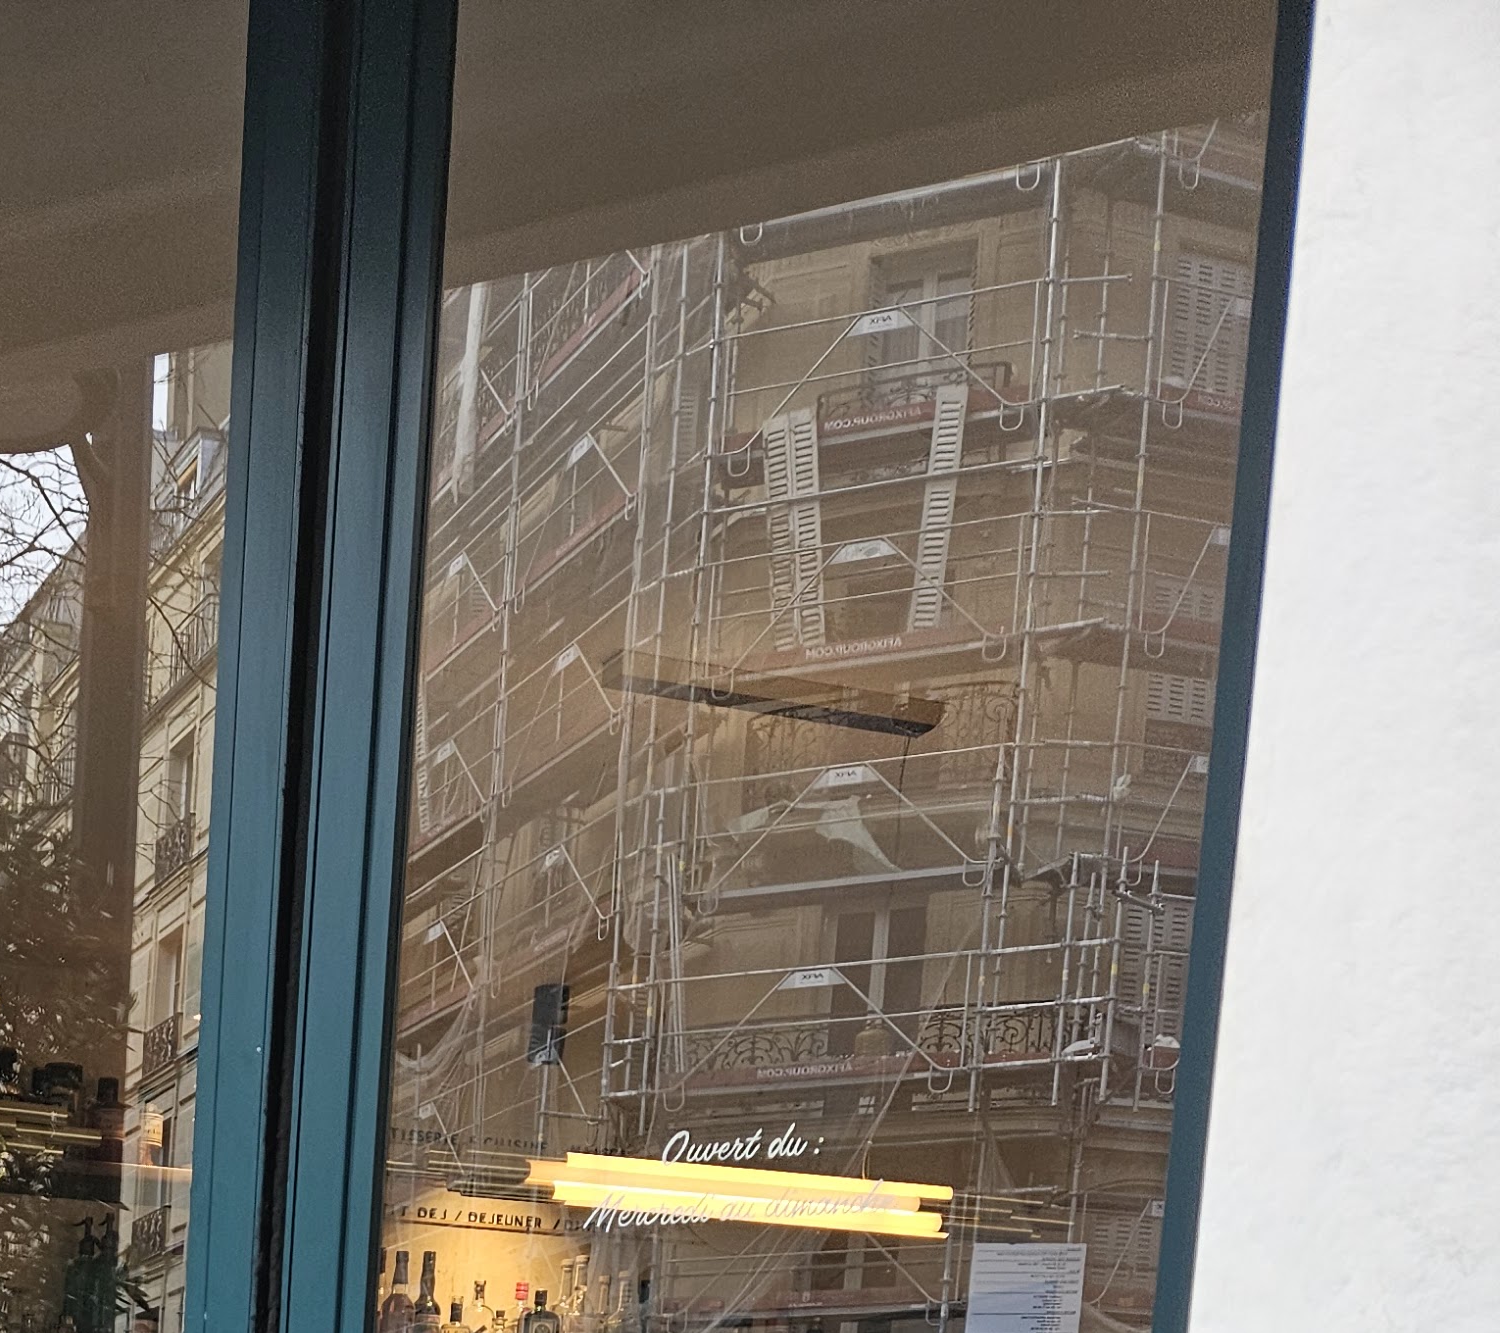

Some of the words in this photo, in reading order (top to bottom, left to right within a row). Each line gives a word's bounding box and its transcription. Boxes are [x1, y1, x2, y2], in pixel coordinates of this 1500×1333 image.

[661, 1129, 761, 1167] Ouvert
[768, 1122, 810, 1159] du
[417, 1206, 448, 1221] DEJ
[468, 1210, 543, 1230] DEJEUNER
[584, 1192, 713, 1233] Mercredi
[718, 1199, 755, 1222] au
